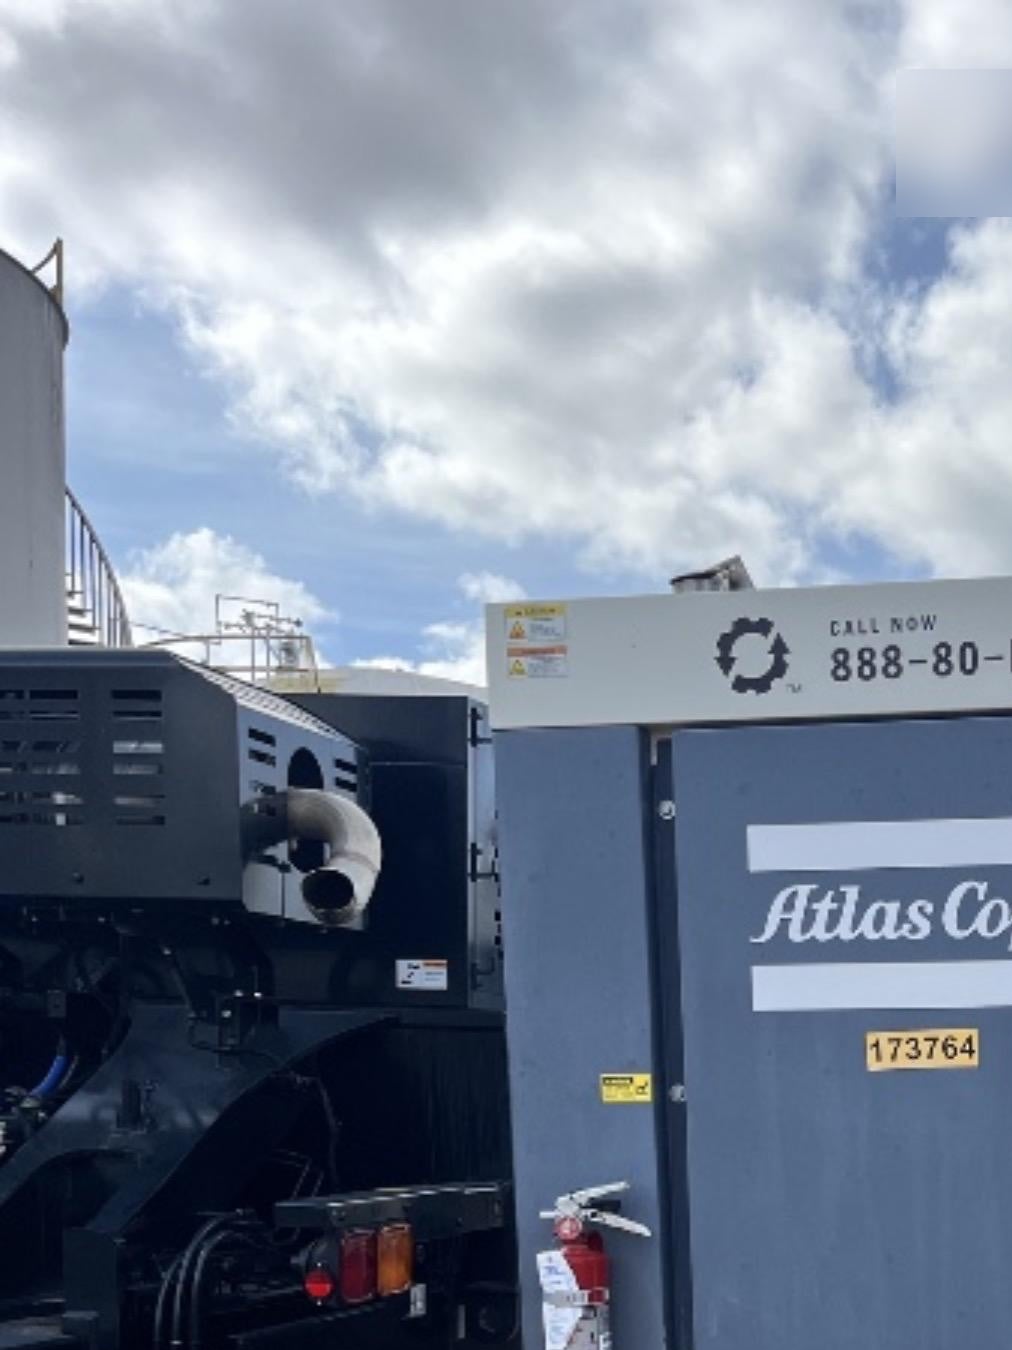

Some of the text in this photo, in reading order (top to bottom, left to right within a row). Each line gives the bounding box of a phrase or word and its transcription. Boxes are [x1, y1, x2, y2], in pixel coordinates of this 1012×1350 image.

[830, 614, 937, 636] CALL NOW
[749, 883, 934, 943] Atlas
[869, 1034, 976, 1063] 173764
